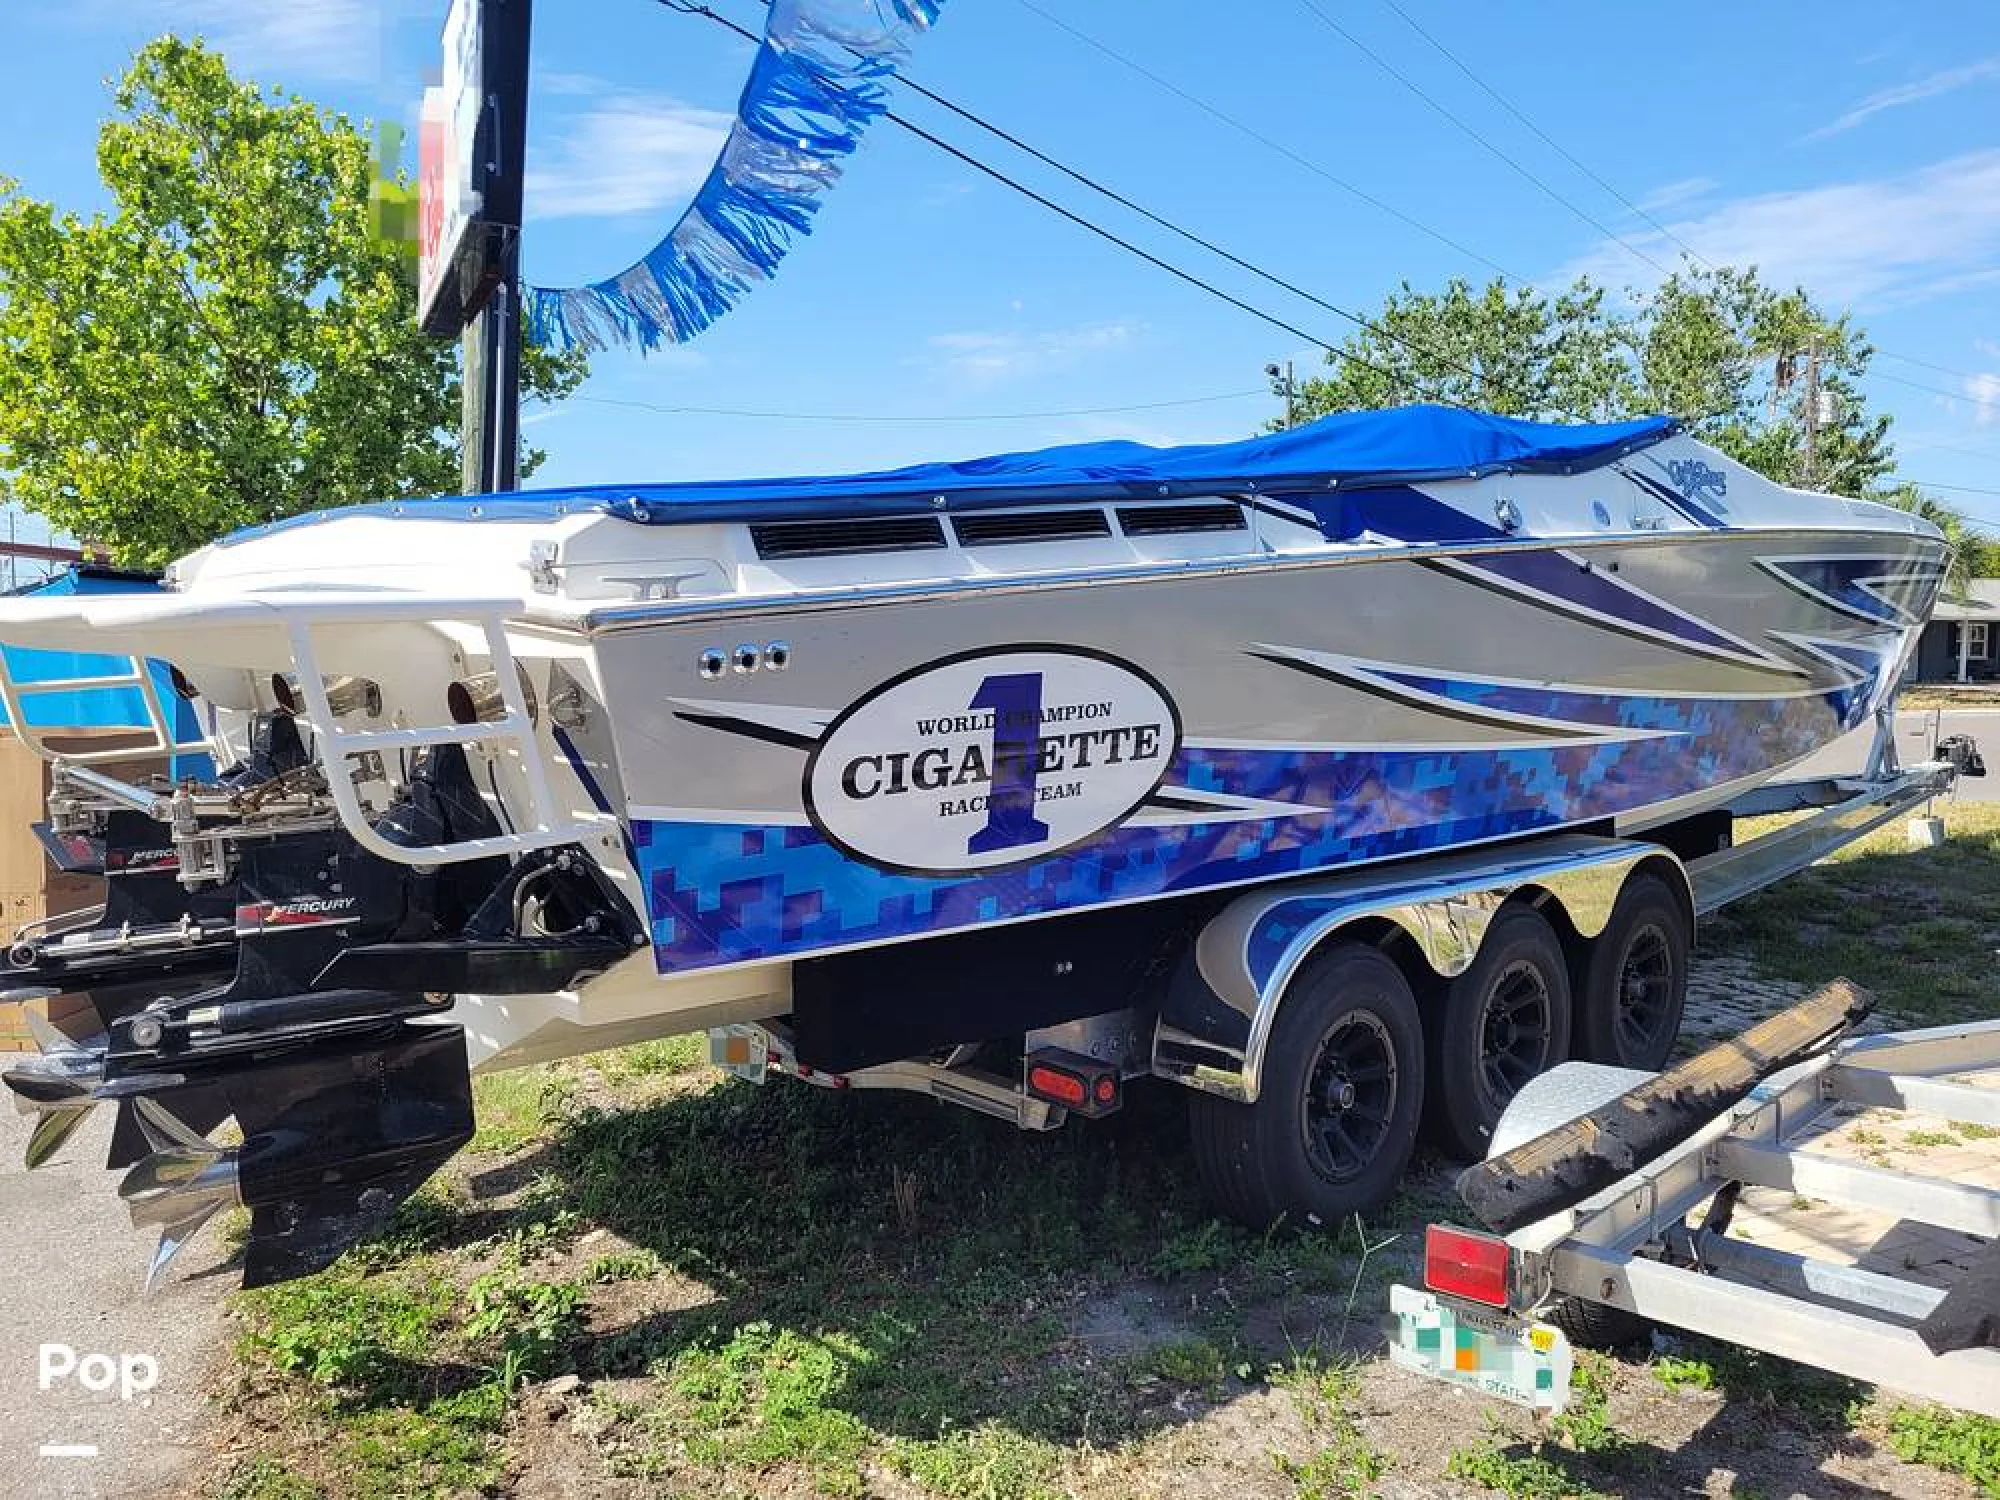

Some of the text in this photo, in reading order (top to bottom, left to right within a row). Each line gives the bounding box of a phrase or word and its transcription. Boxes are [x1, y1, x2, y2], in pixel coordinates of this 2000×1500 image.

[916, 713, 995, 736] WORLD
[968, 672, 1048, 854] 1
[267, 898, 355, 920] MERCURY
